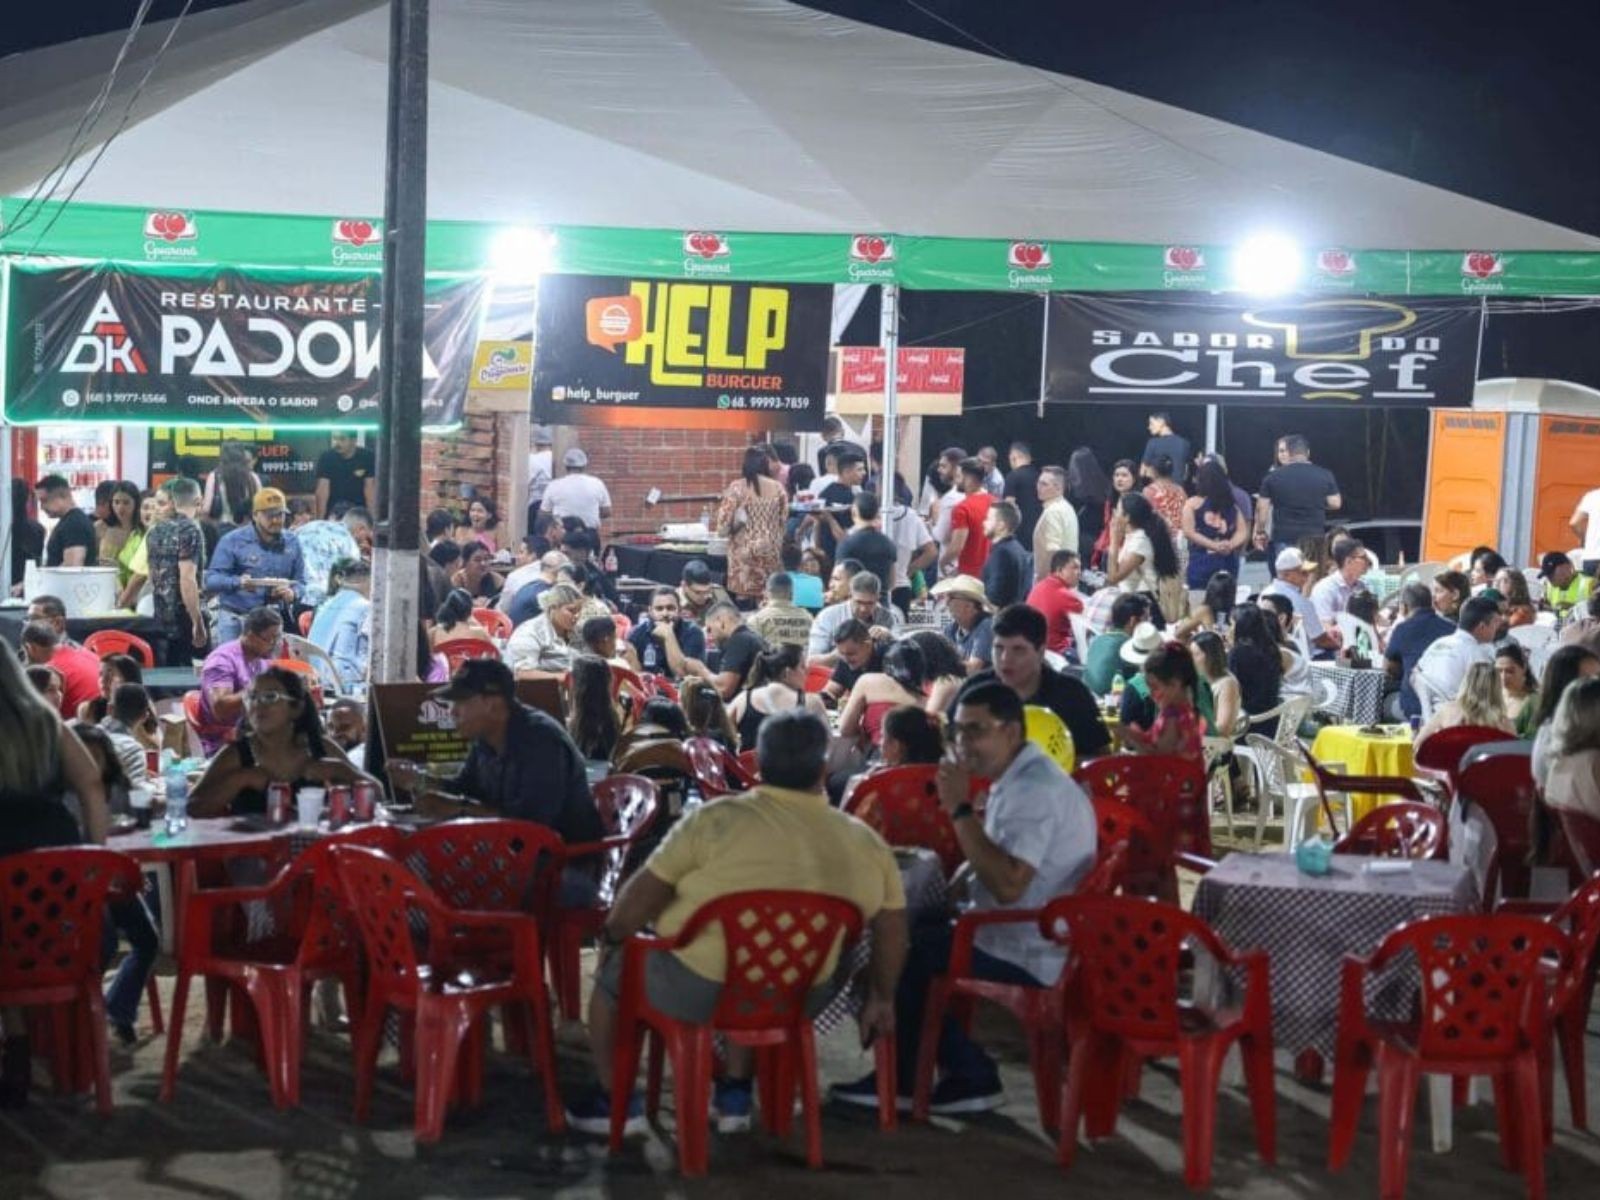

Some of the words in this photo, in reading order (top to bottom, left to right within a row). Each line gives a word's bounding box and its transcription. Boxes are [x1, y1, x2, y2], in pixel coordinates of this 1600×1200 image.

[161, 292, 366, 313] RESTAURANTE
[625, 281, 789, 387] HELP
[1092, 330, 1274, 349] SABOR
[1382, 337, 1440, 351] DO
[161, 314, 441, 379] PADOK
[1090, 348, 1438, 390] Chef
[706, 373, 782, 391] BURGUER
[188, 395, 221, 405] ONDE
[223, 396, 265, 407] IMPERA
[268, 397, 277, 406] O
[281, 397, 318, 408] SABOR
[567, 386, 640, 404] help_burguer
[750, 396, 810, 409] 99993-7859
